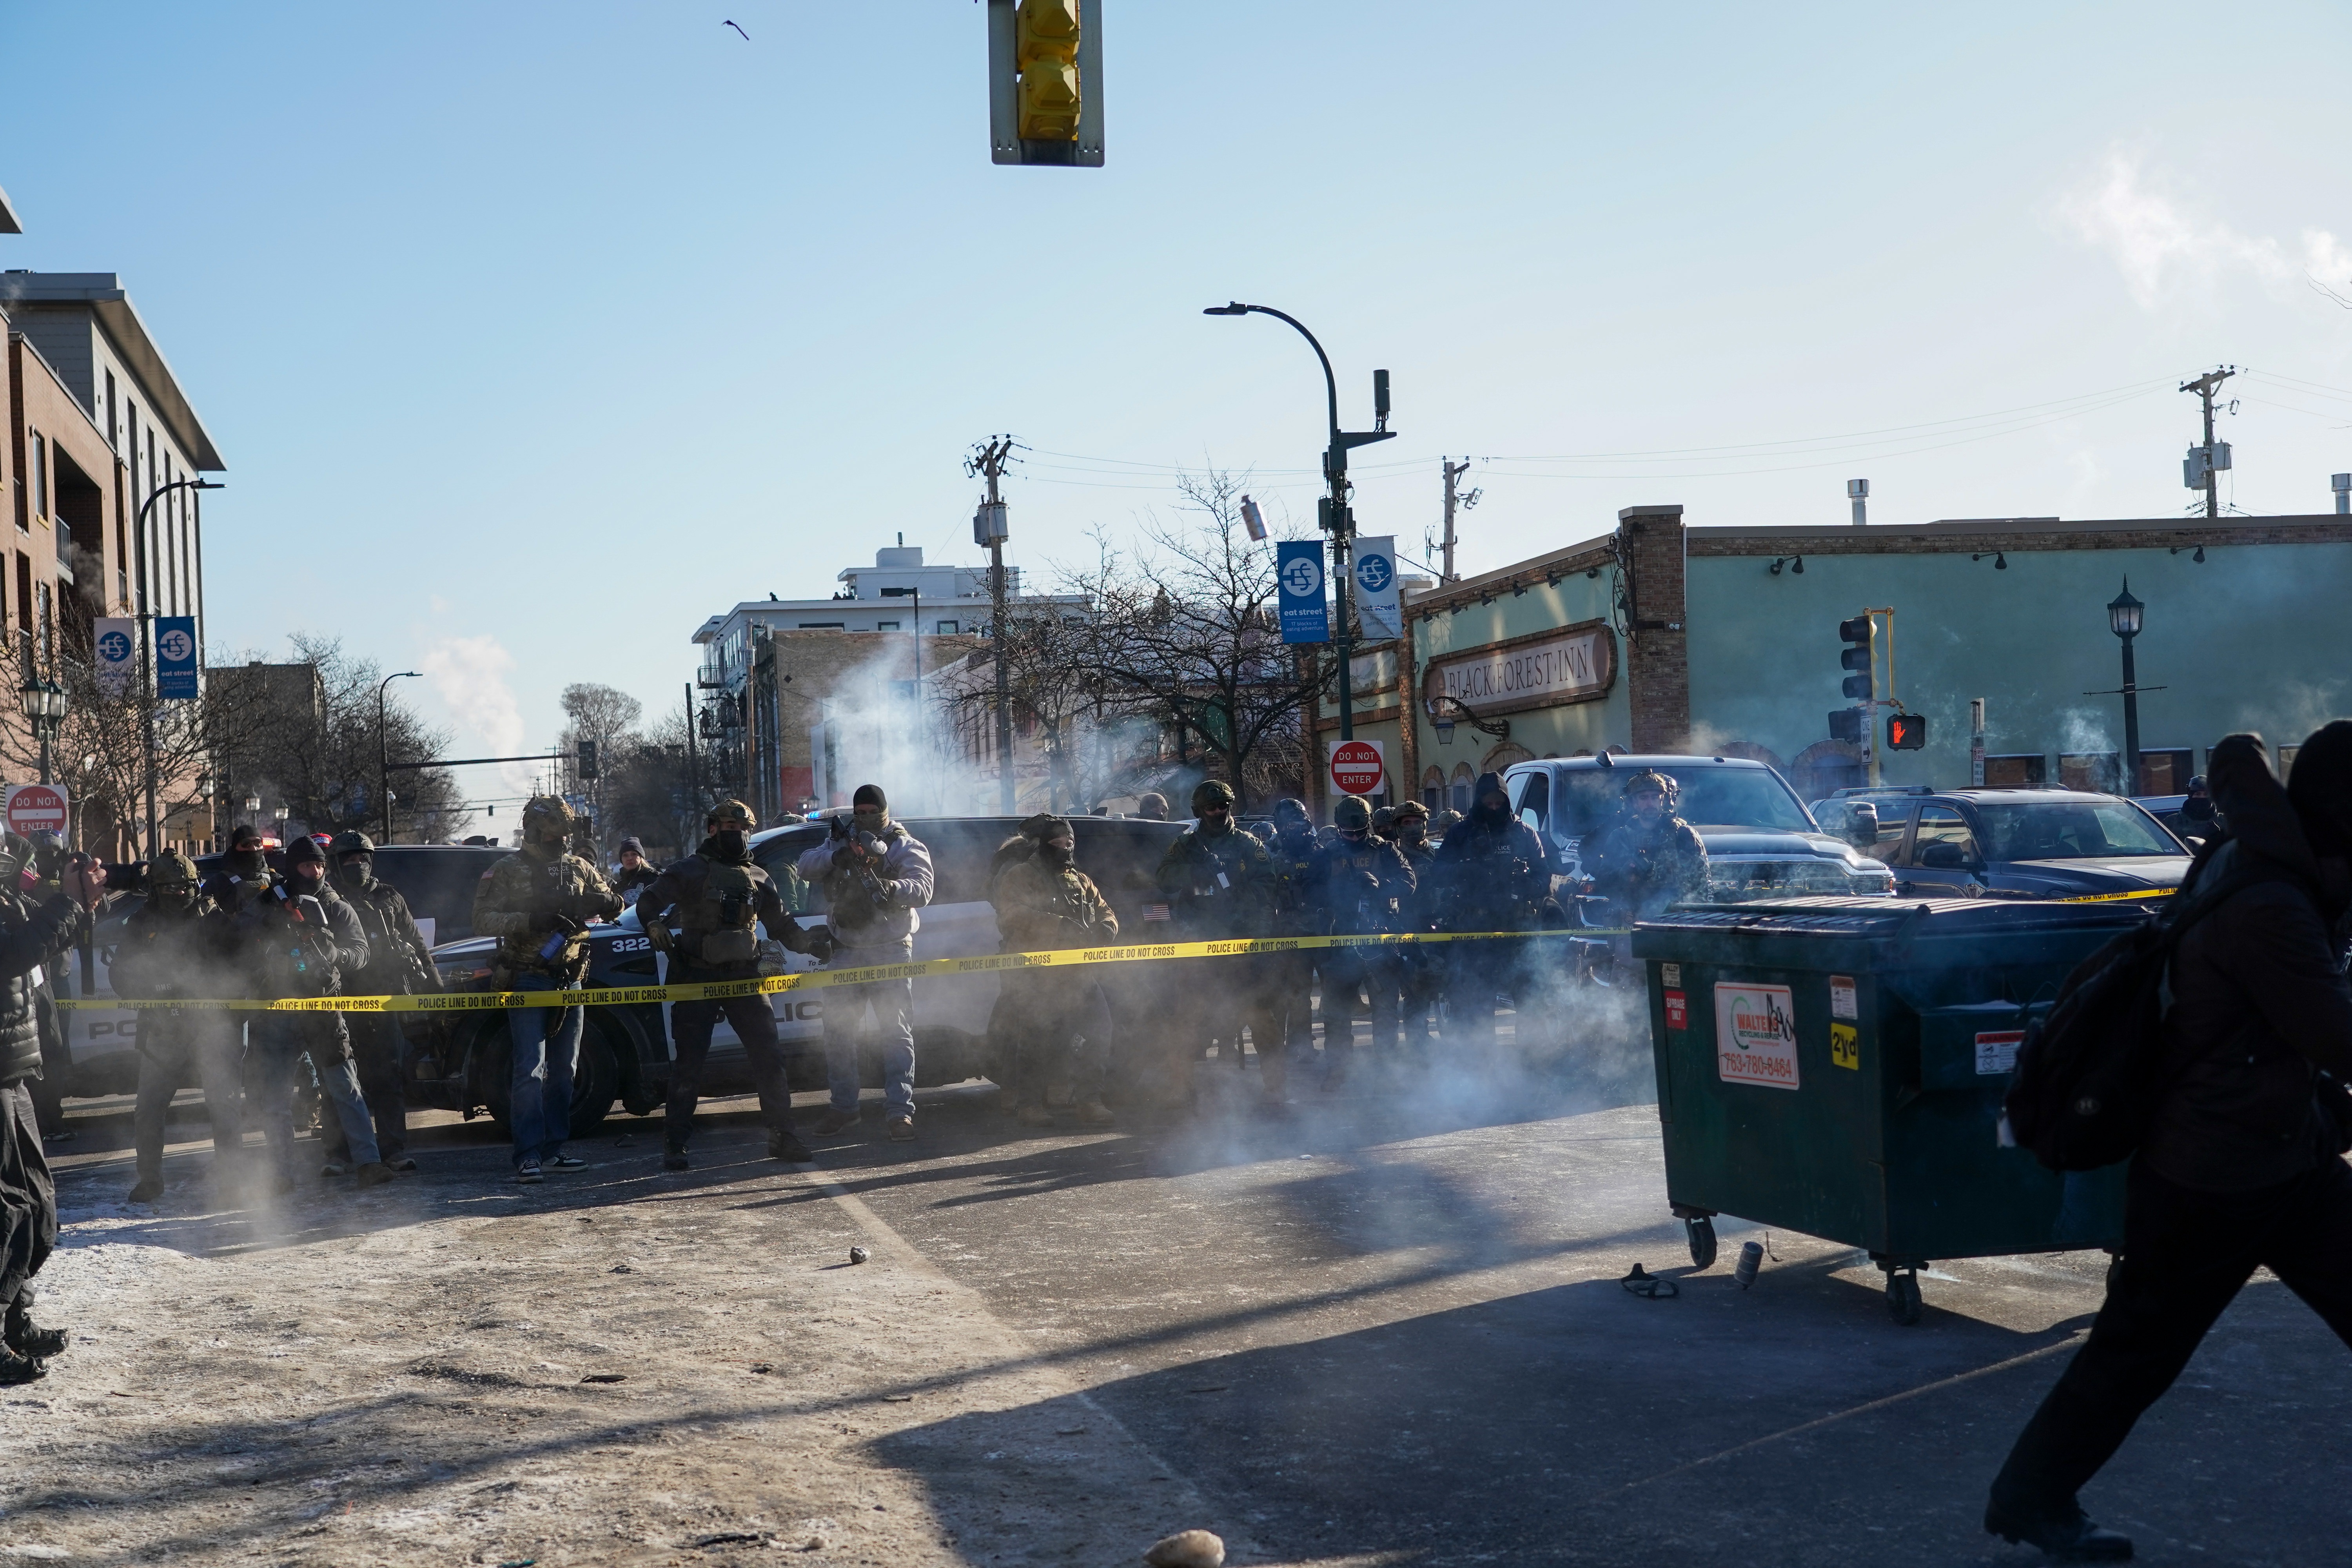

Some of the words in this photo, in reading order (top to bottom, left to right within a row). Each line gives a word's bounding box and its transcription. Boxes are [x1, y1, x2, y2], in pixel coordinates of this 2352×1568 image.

[1449, 665, 1494, 699] BLACK
[1497, 652, 1552, 693] FOREST
[1558, 644, 1587, 682] INN
[16, 797, 30, 806] DO
[37, 797, 57, 806] NOT
[21, 822, 53, 831] ENTER
[612, 937, 651, 953] 322
[1207, 944, 1231, 953] POLICE
[1233, 943, 1248, 952] LINE
[1250, 942, 1259, 951] DO
[1261, 942, 1274, 951] NOT
[1276, 941, 1298, 950] CROSS
[1083, 951, 1107, 960] POLICE
[1110, 949, 1124, 959] LINE
[1126, 949, 1135, 958] DO
[1138, 947, 1151, 957] NOT
[1152, 946, 1175, 956] CROSS
[959, 960, 983, 971] POLICE
[985, 958, 1000, 969] LINE
[1002, 958, 1011, 967] DO
[1013, 956, 1027, 966] NOT
[1028, 955, 1051, 964] CROSS
[1666, 964, 1678, 973] ALLOY
[833, 972, 858, 984] POLICE
[860, 969, 875, 981] LINE
[877, 969, 886, 979] DO
[888, 967, 902, 978] NOT
[904, 964, 926, 976] CROSS
[704, 985, 730, 997] POLICE
[733, 983, 748, 995] LINE
[750, 982, 760, 993] DO
[762, 980, 775, 992] NOT
[777, 978, 800, 990] CROSS
[418, 998, 446, 1009] POLICE
[449, 997, 466, 1008] LINE
[468, 996, 479, 1007] DO
[481, 996, 497, 1007] NOT
[499, 995, 525, 1006] CROSS
[563, 993, 590, 1004] POLICE
[592, 992, 609, 1003] LINE
[612, 991, 622, 1002] DO
[624, 990, 640, 1001] NOT
[642, 989, 667, 1000] CROSS
[56, 1002, 77, 1010] ROSS
[270, 1001, 298, 1010] POLICE
[301, 1001, 318, 1010] LINE
[321, 1001, 332, 1010] DO
[335, 1000, 350, 1009] NOT
[353, 1000, 379, 1009] CROSS
[1666, 998, 1685, 1009] GARBAGE
[1671, 1010, 1681, 1020] ONLY
[1739, 1030, 1760, 1038] RECYCLING
[1725, 1053, 1792, 1078] 763-780-8464
